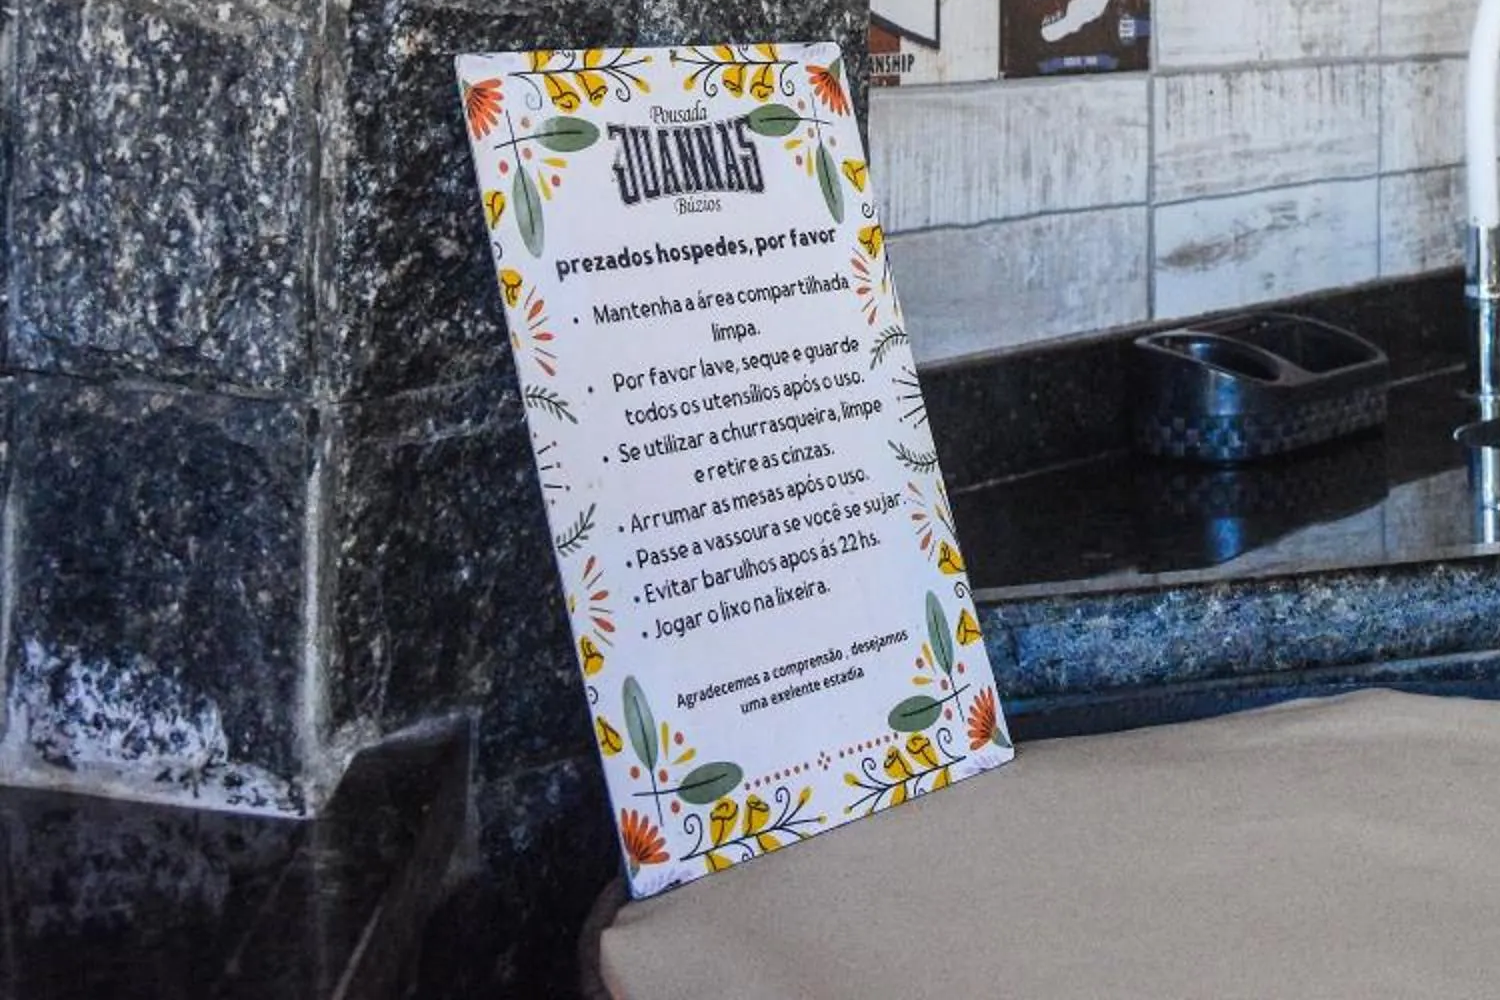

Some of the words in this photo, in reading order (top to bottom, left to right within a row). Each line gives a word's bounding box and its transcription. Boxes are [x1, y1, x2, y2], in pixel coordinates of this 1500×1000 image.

[868, 53, 915, 73] ANSHIP
[651, 100, 707, 124] Pousada
[674, 196, 722, 215] Búzios
[556, 246, 653, 282] prezados
[656, 235, 753, 265] hospedes,
[755, 233, 786, 257] por
[790, 228, 836, 247] favor
[593, 296, 682, 324] Mantenha
[685, 297, 695, 311] a
[696, 290, 734, 309] área
[737, 273, 850, 304] compartilhada
[711, 322, 761, 343] limpa.
[613, 373, 645, 392] Por
[649, 364, 696, 386] favor
[699, 357, 740, 378] lave,
[742, 350, 790, 371] seque
[792, 348, 801, 361] e
[804, 336, 859, 364] guarde
[625, 402, 678, 425] todos
[680, 399, 700, 416] os
[702, 383, 780, 411] utensílios
[783, 373, 821, 400] após
[822, 376, 833, 389] o
[835, 371, 865, 387] uso.
[618, 442, 641, 463] Se
[643, 432, 704, 457] utilizar
[709, 431, 719, 445] a
[721, 407, 841, 442] churrasqueira,
[840, 399, 882, 421] limpe
[693, 469, 705, 483] e
[707, 457, 759, 481] retire
[761, 453, 779, 469] as
[781, 443, 835, 465] cinzas.
[631, 502, 707, 534] Arrumar
[712, 499, 731, 515] as
[732, 485, 785, 511] mesas
[786, 472, 825, 500] após
[826, 475, 837, 489] o
[839, 469, 870, 486] uso.
[636, 543, 689, 569] Passe
[692, 541, 703, 555] a
[704, 522, 781, 551] vassoura
[783, 517, 801, 533] se
[803, 502, 841, 527] você
[844, 503, 861, 519] se
[644, 576, 699, 603] Evitar
[701, 558, 777, 589] barulhos
[655, 611, 703, 639] Jogar
[707, 609, 719, 623] o
[719, 600, 751, 621] lixo
[754, 596, 775, 612] na
[776, 580, 831, 605] lixeira.
[677, 673, 761, 709] Agradecemos
[763, 671, 771, 683] a
[850, 629, 909, 655] desejamos
[740, 697, 769, 714] uma
[770, 680, 821, 704] exelente
[823, 666, 865, 688] estadia
